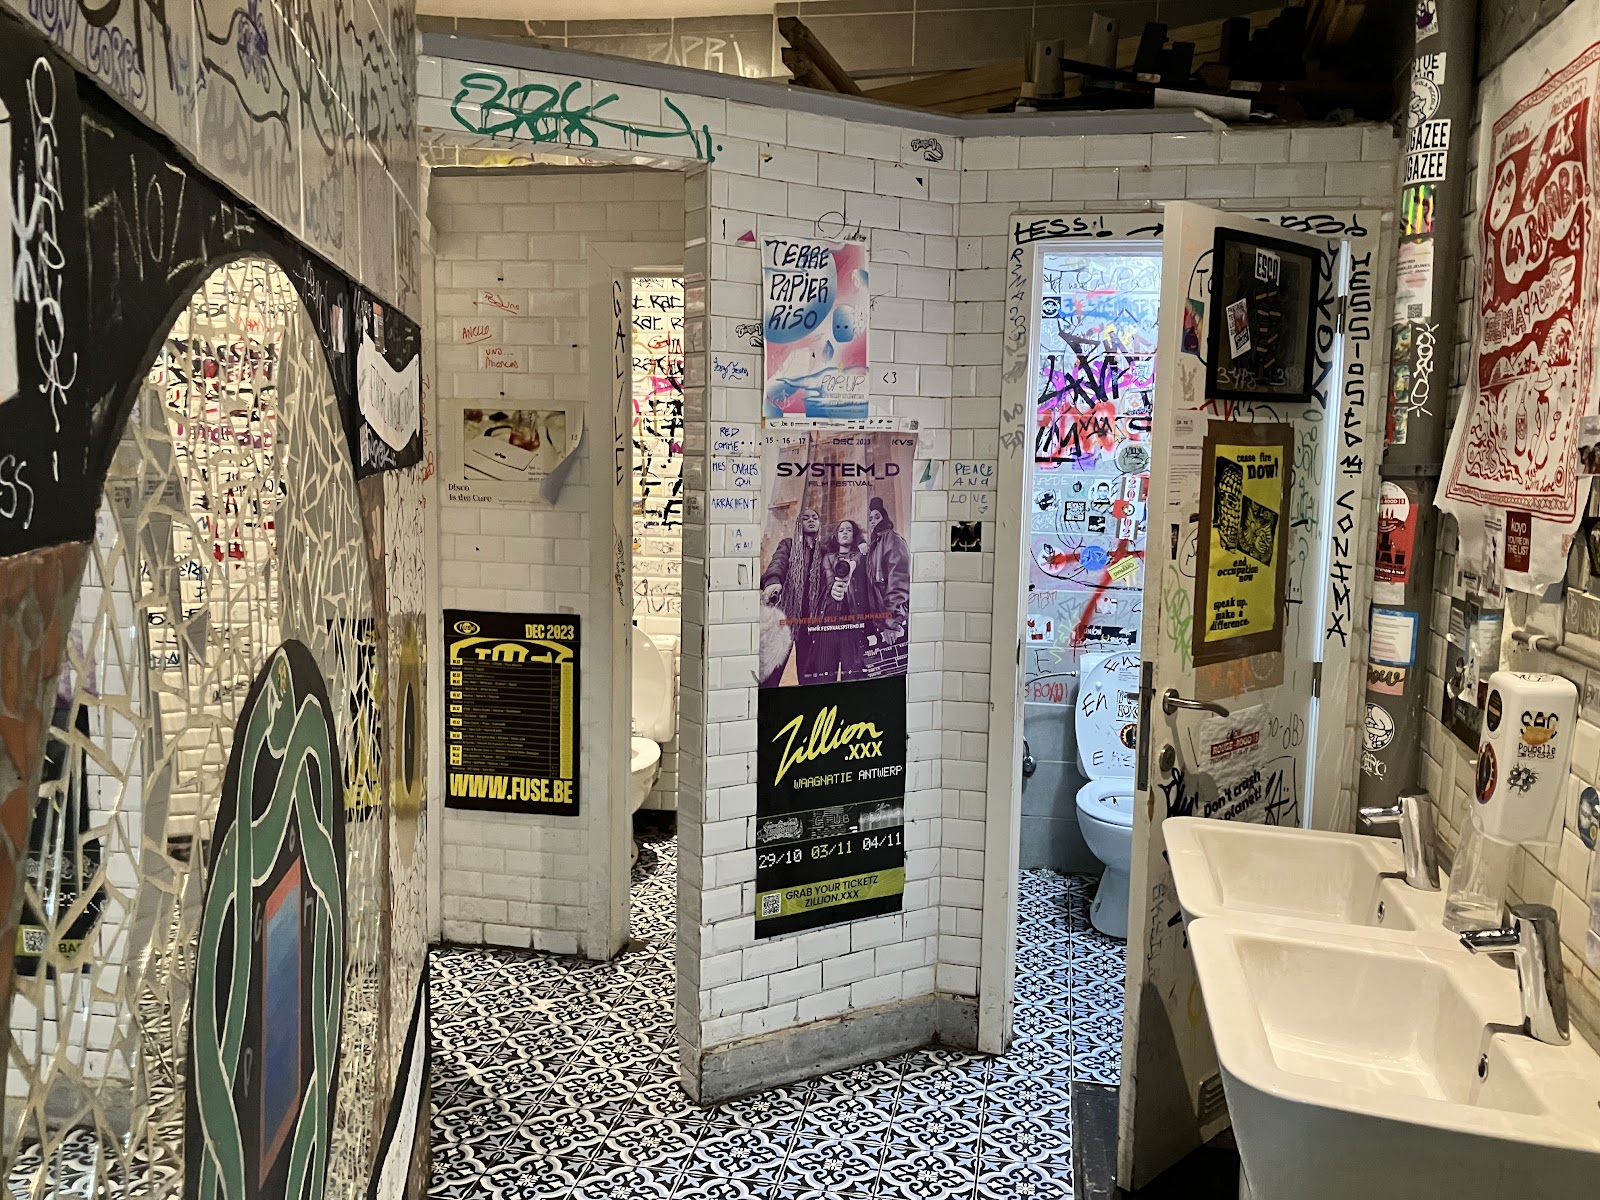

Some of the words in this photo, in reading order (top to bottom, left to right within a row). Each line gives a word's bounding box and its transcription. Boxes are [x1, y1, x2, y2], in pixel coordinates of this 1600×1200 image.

[765, 240, 829, 269] TERRE
[719, 426, 740, 437] RED
[832, 438, 854, 446] DEC
[891, 438, 914, 446] KVS
[1237, 453, 1256, 463] cease
[1259, 452, 1272, 463] fire
[954, 462, 993, 477] PEACE
[1233, 557, 1247, 568] end
[1217, 564, 1259, 577] occupation
[1238, 572, 1254, 583] now
[1213, 598, 1236, 611] speak
[1215, 610, 1235, 620] make
[525, 624, 545, 639] DEC
[547, 624, 575, 640] 2023
[858, 765, 903, 781] ANTWERP
[450, 773, 573, 804] WWW.FUSE.BE
[1233, 769, 1261, 797] crash
[758, 848, 803, 869] 29/10
[811, 841, 853, 860] 03/11
[862, 832, 902, 851] 04/11
[785, 887, 812, 900] GRAB
[815, 882, 841, 896] YOUR
[843, 875, 879, 889] TICKETZ
[804, 890, 859, 908] ZILLION.XXX
